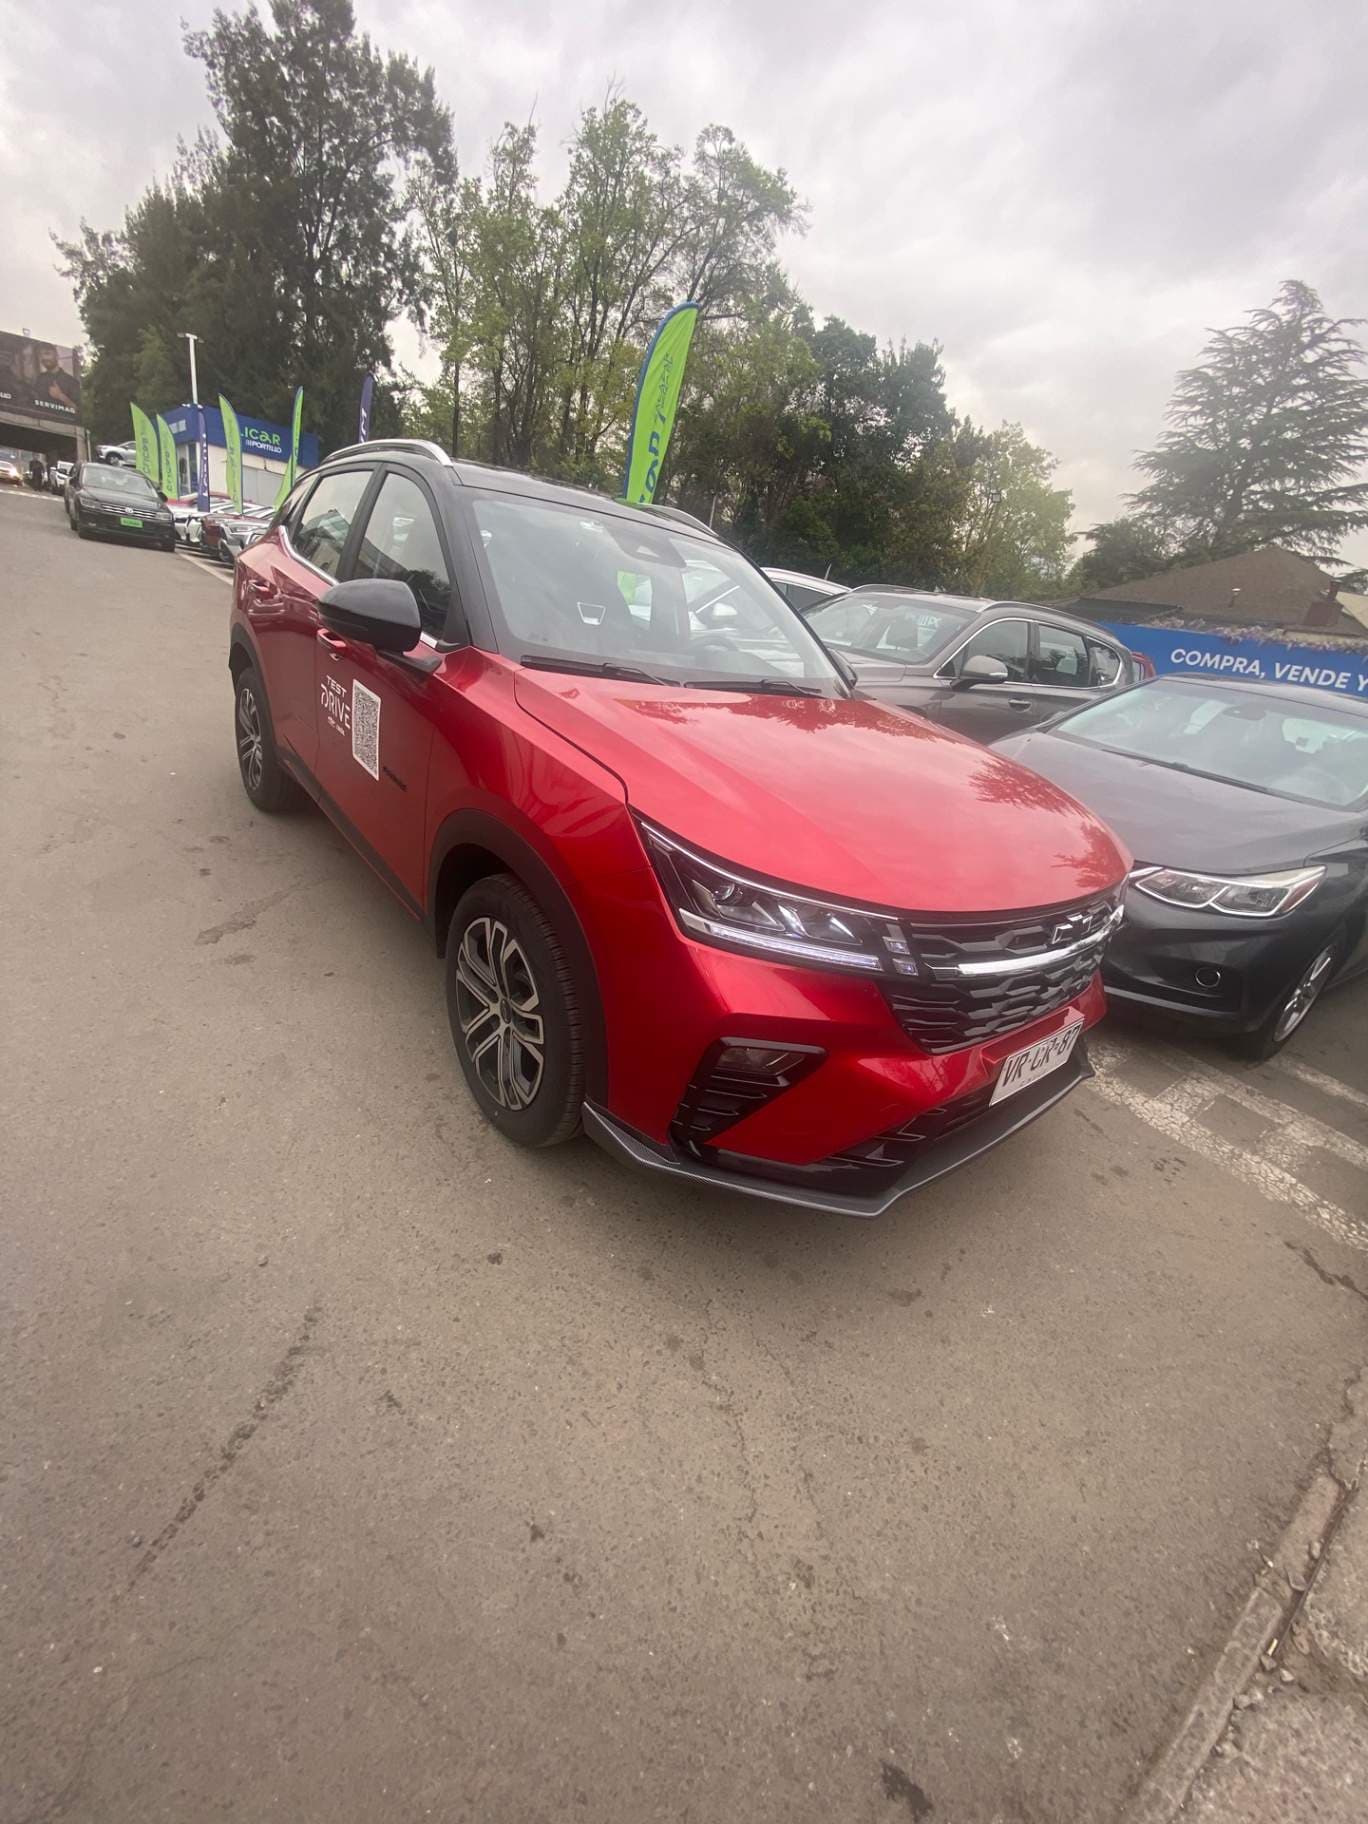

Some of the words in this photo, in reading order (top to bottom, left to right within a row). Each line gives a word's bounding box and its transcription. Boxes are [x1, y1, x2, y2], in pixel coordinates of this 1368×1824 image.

[326, 674, 348, 698] TEST
[1170, 648, 1266, 679] COMPRA,
[1273, 661, 1351, 689] VENDE
[1357, 674, 1368, 692] Y
[320, 683, 351, 730] DRIVE
